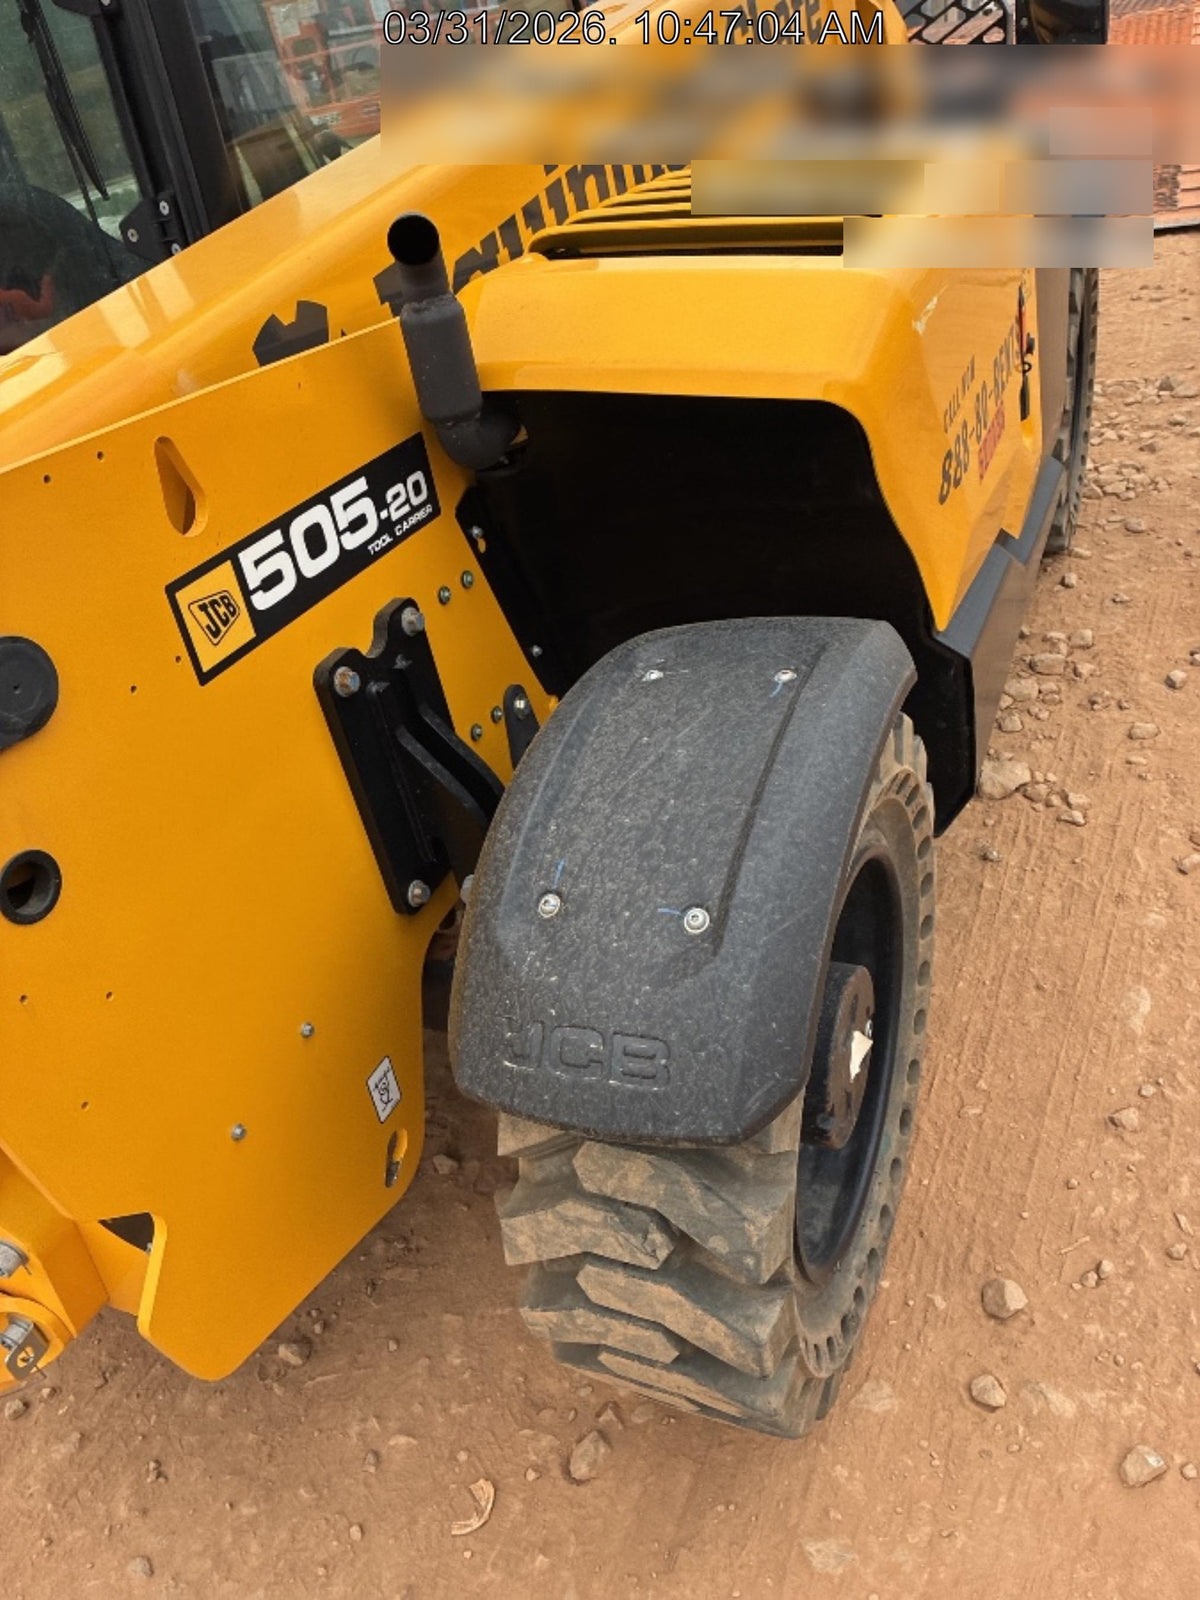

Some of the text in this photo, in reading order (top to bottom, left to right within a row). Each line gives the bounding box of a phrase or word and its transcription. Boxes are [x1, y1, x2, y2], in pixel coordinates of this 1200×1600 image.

[238, 470, 428, 611] 505-20
[367, 504, 433, 555] TOOL CARRIER
[197, 594, 238, 640] JCB
[499, 1015, 671, 1090] JCB
